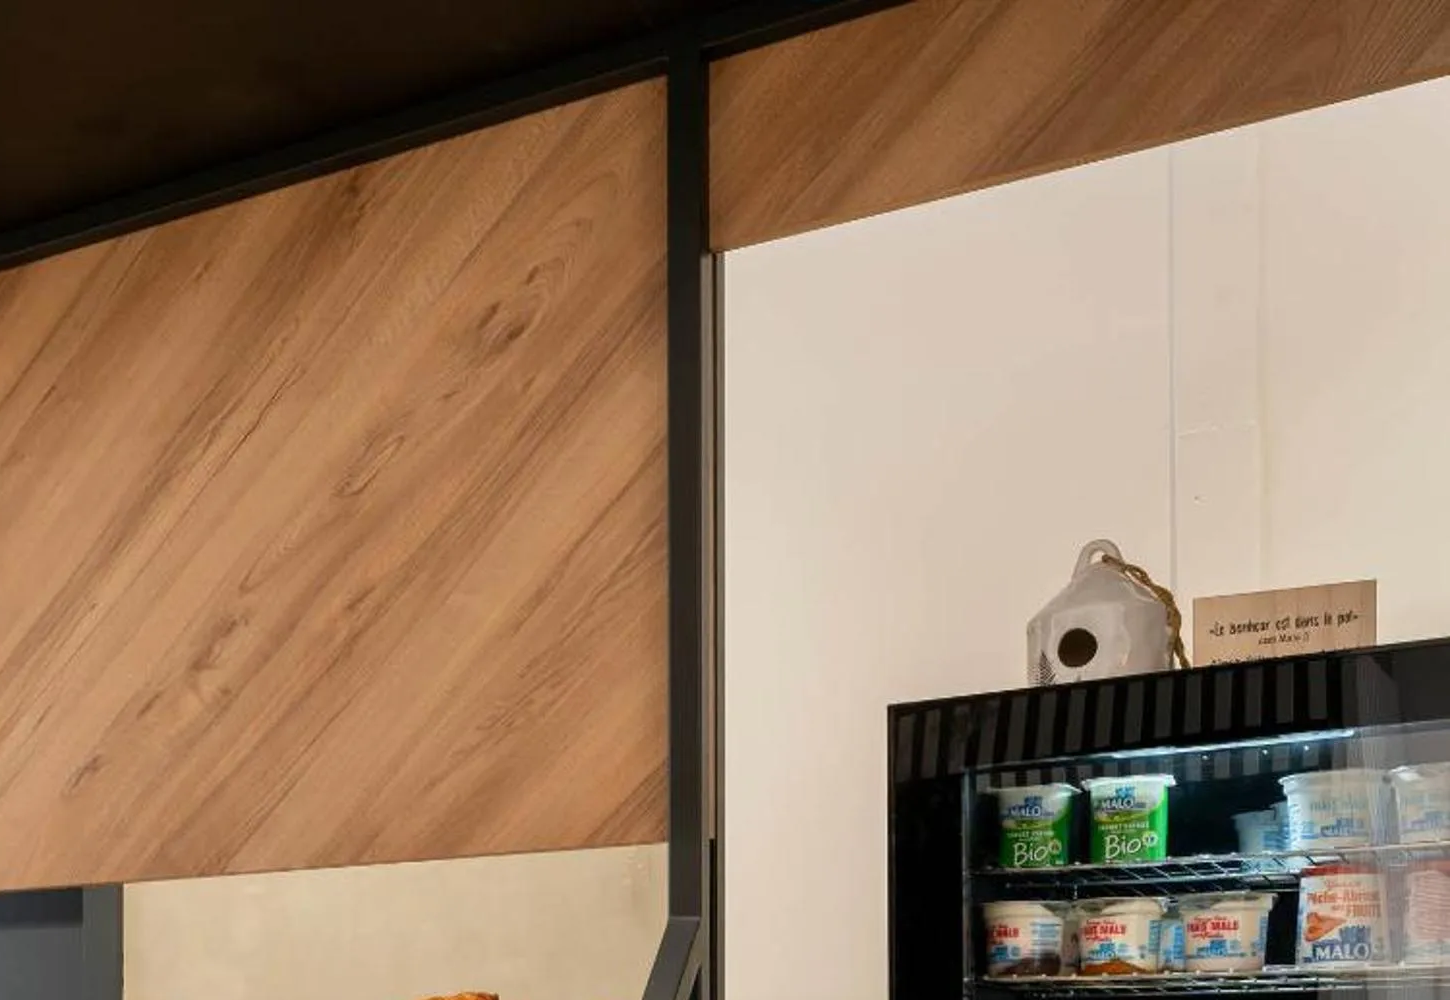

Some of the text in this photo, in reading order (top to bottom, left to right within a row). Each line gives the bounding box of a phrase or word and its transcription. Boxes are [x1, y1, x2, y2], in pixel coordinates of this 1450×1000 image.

[1012, 842, 1049, 866] Bio
[1104, 834, 1142, 859] Bio
[1316, 943, 1370, 960] MALO
